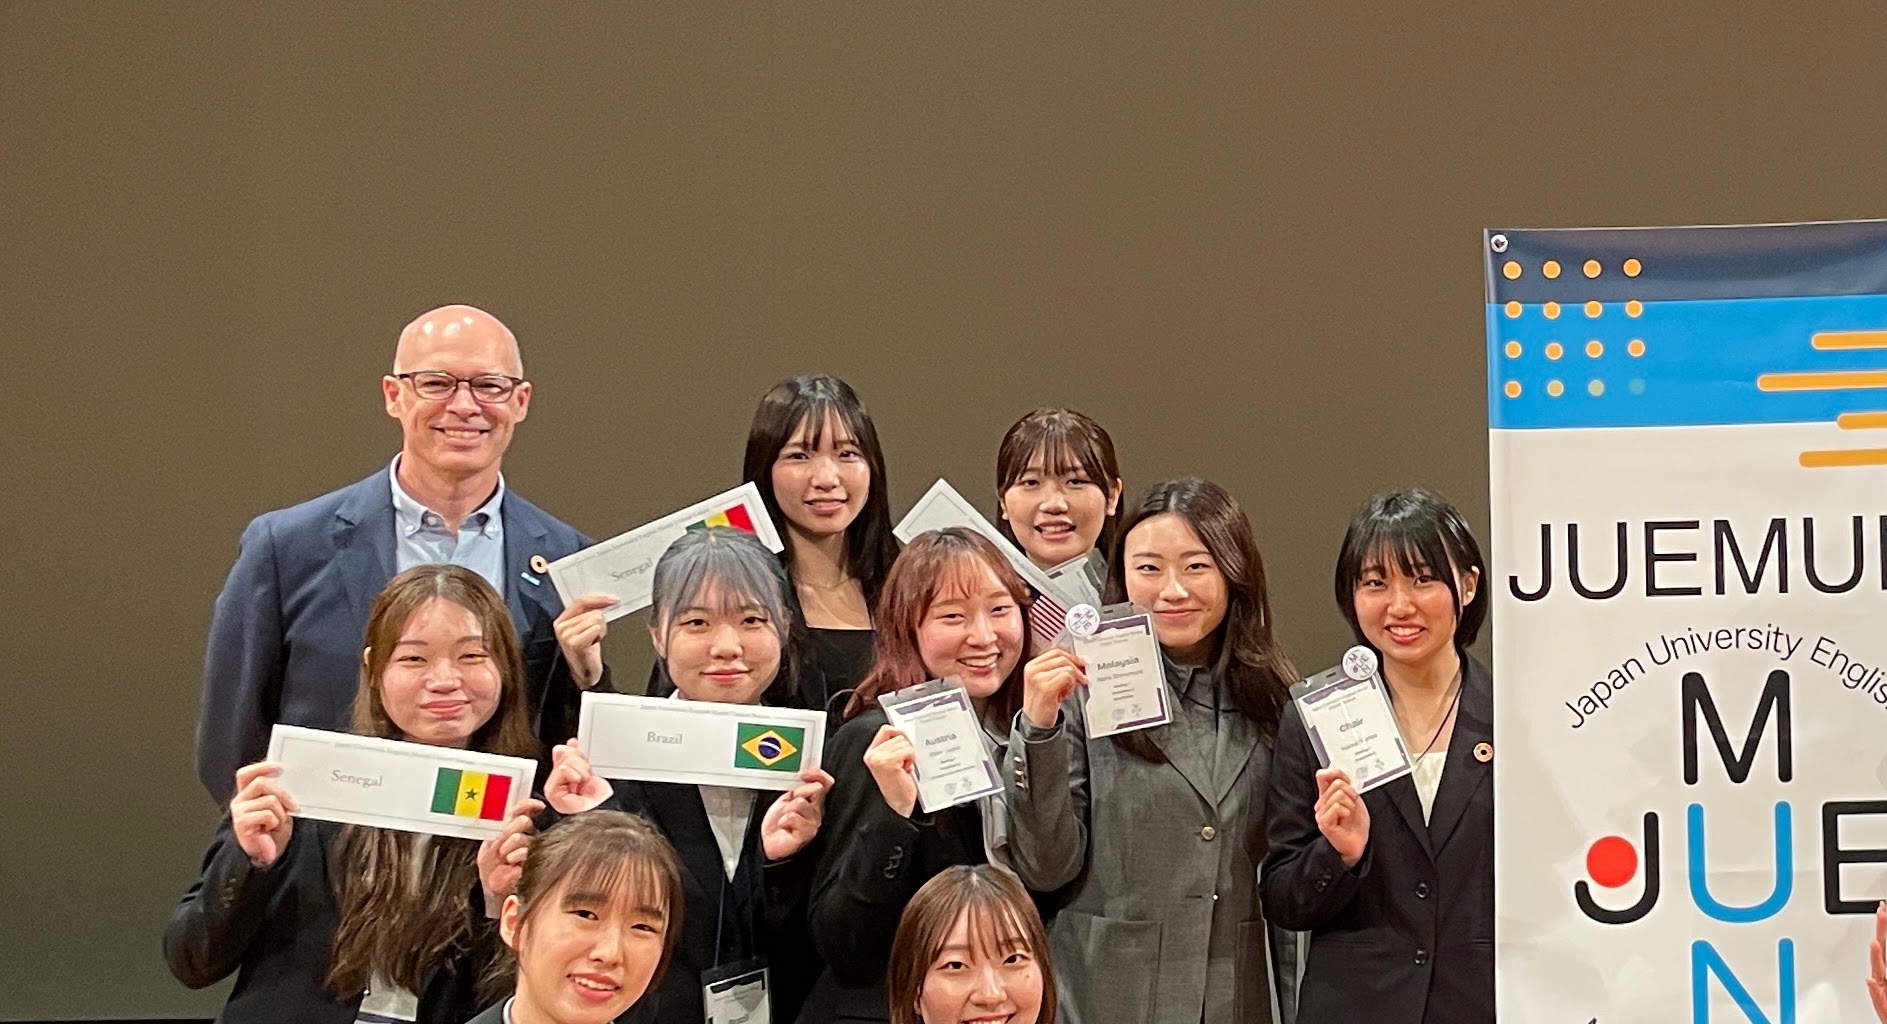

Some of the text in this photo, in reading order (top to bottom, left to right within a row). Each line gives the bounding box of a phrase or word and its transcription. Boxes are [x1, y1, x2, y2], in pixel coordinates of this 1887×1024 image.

[611, 558, 655, 582] Senegal
[1564, 657, 1646, 729] Japan
[1645, 623, 1804, 665] University
[1339, 717, 1364, 733] Chair
[646, 730, 684, 746] Brazil
[331, 769, 383, 788] Senegal
